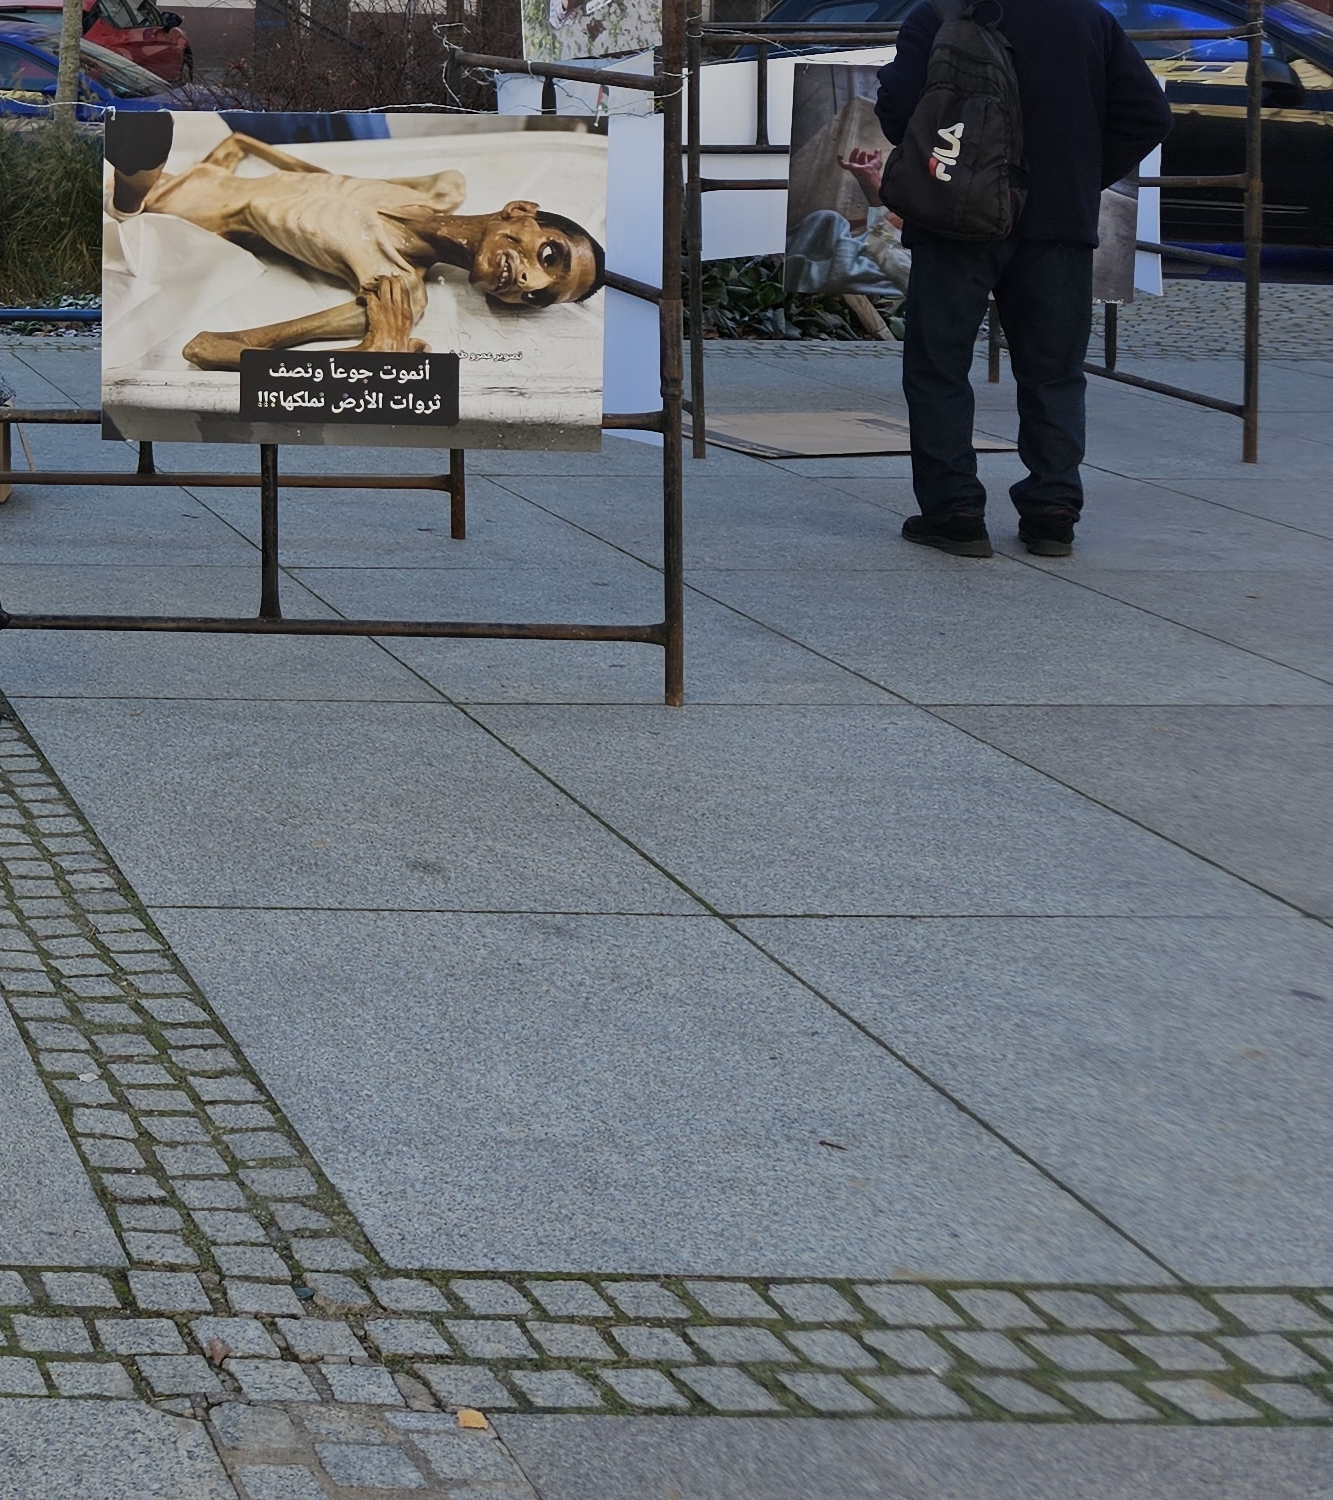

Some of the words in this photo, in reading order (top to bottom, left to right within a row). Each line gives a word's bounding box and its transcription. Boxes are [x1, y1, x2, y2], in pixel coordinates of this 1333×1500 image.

[929, 122, 965, 182] FILA
[269, 362, 324, 383] ونصف
[329, 357, 374, 384] جوعاً
[379, 359, 430, 384] أنموت
[331, 389, 383, 414] الأرض
[389, 393, 442, 414] ثروات
